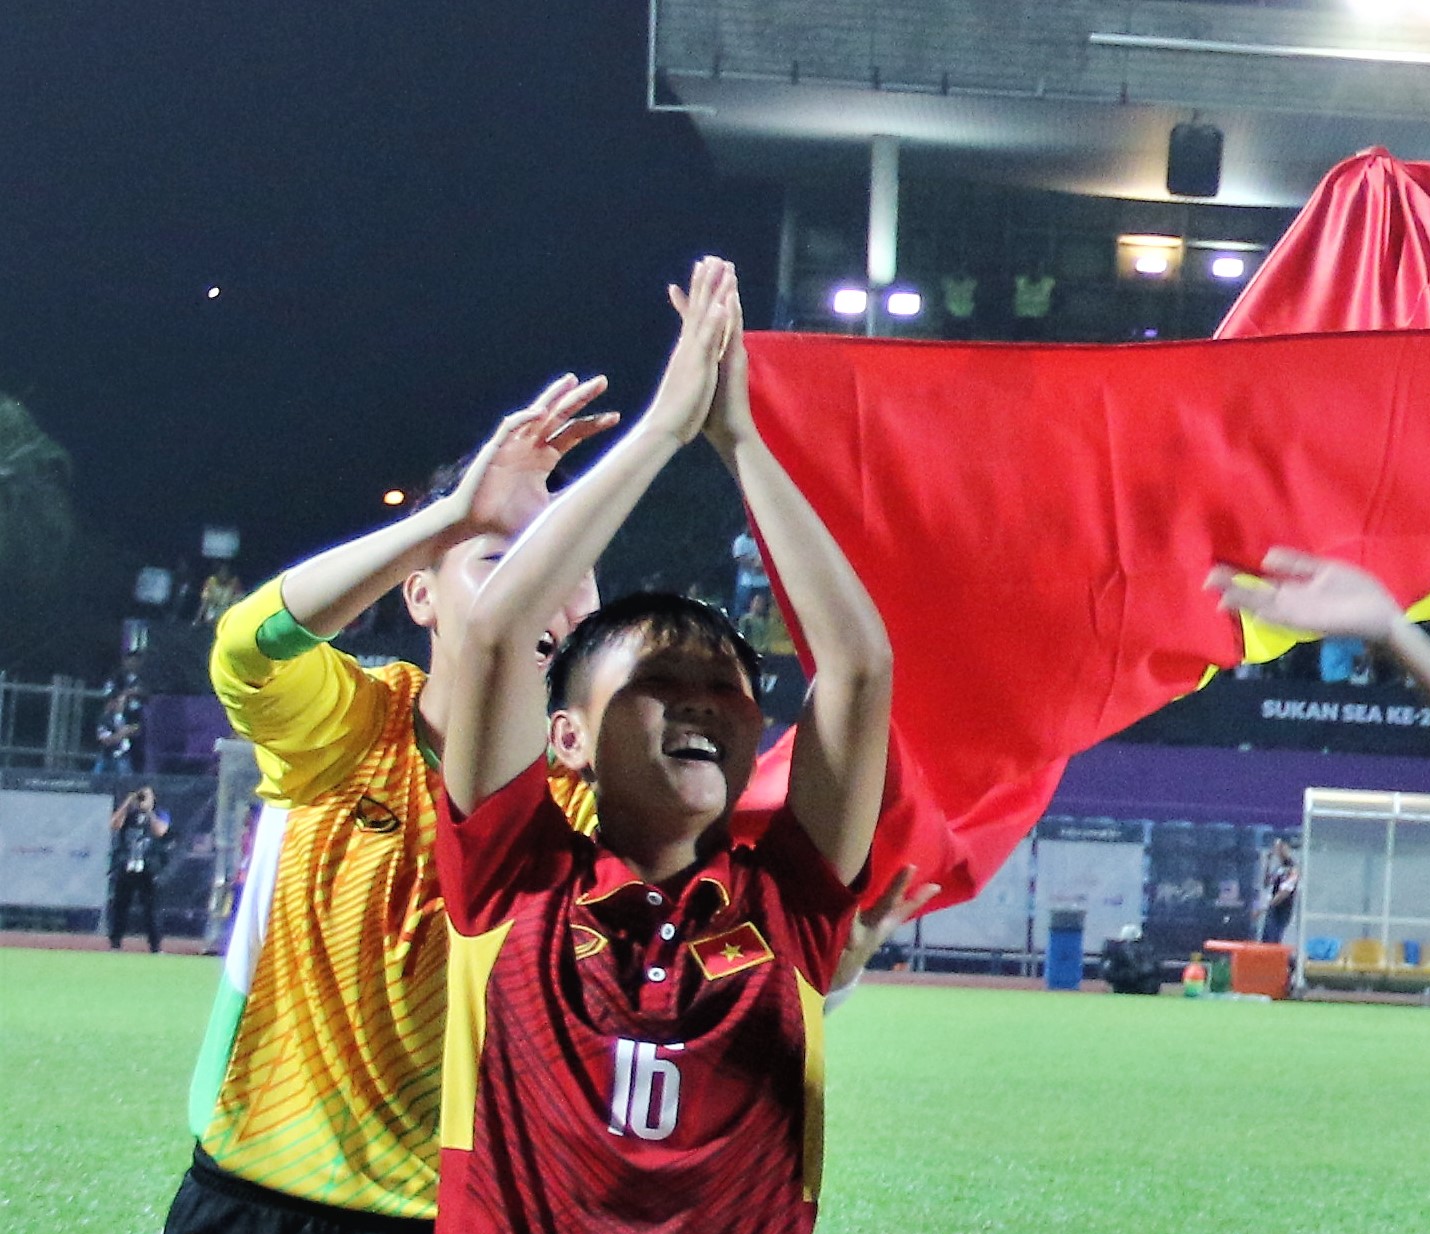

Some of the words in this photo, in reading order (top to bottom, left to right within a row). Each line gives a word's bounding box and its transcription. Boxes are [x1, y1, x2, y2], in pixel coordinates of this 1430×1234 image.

[1261, 700, 1339, 721] SUKAN
[1342, 704, 1382, 724] SEA
[607, 1037, 686, 1140] 16
